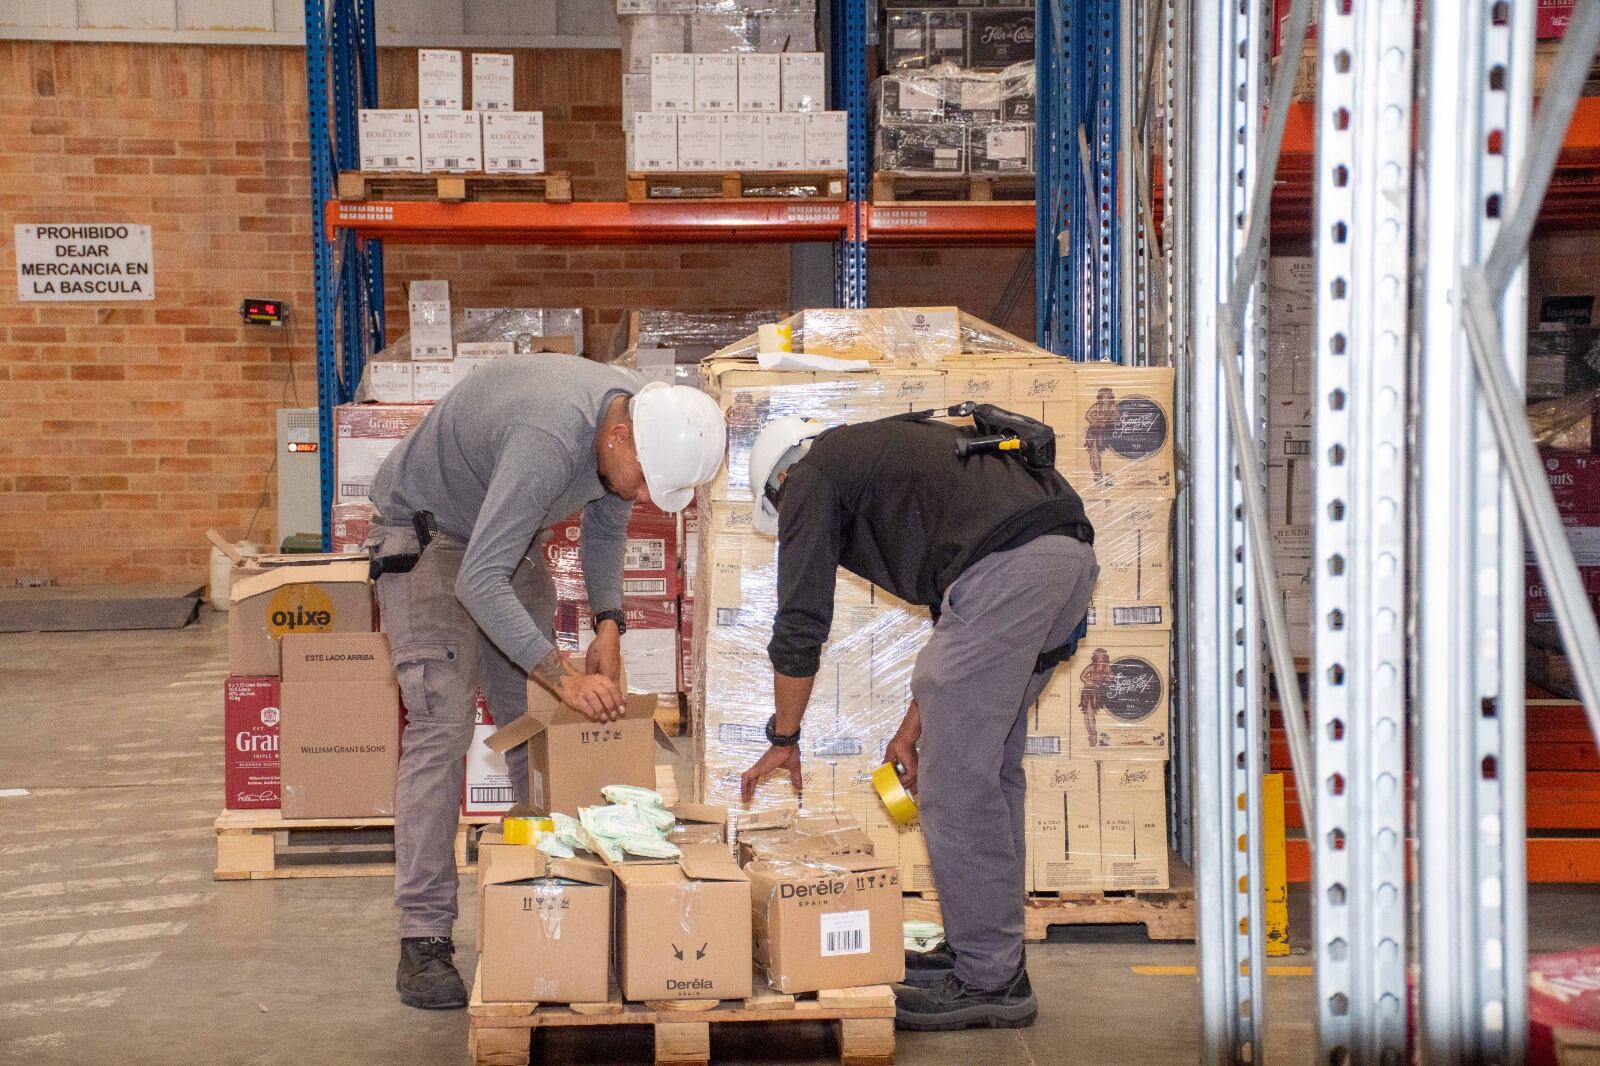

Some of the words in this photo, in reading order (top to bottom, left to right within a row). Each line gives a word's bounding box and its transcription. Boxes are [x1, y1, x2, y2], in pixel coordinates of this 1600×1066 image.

[1014, 104, 1028, 114] 12
[37, 226, 129, 240] PROHIBIDO
[55, 245, 109, 258] DEJAR
[21, 262, 122, 276] MERCANCIA
[126, 263, 148, 275] EN
[33, 281, 55, 294] LA
[60, 280, 142, 294] BASCULA
